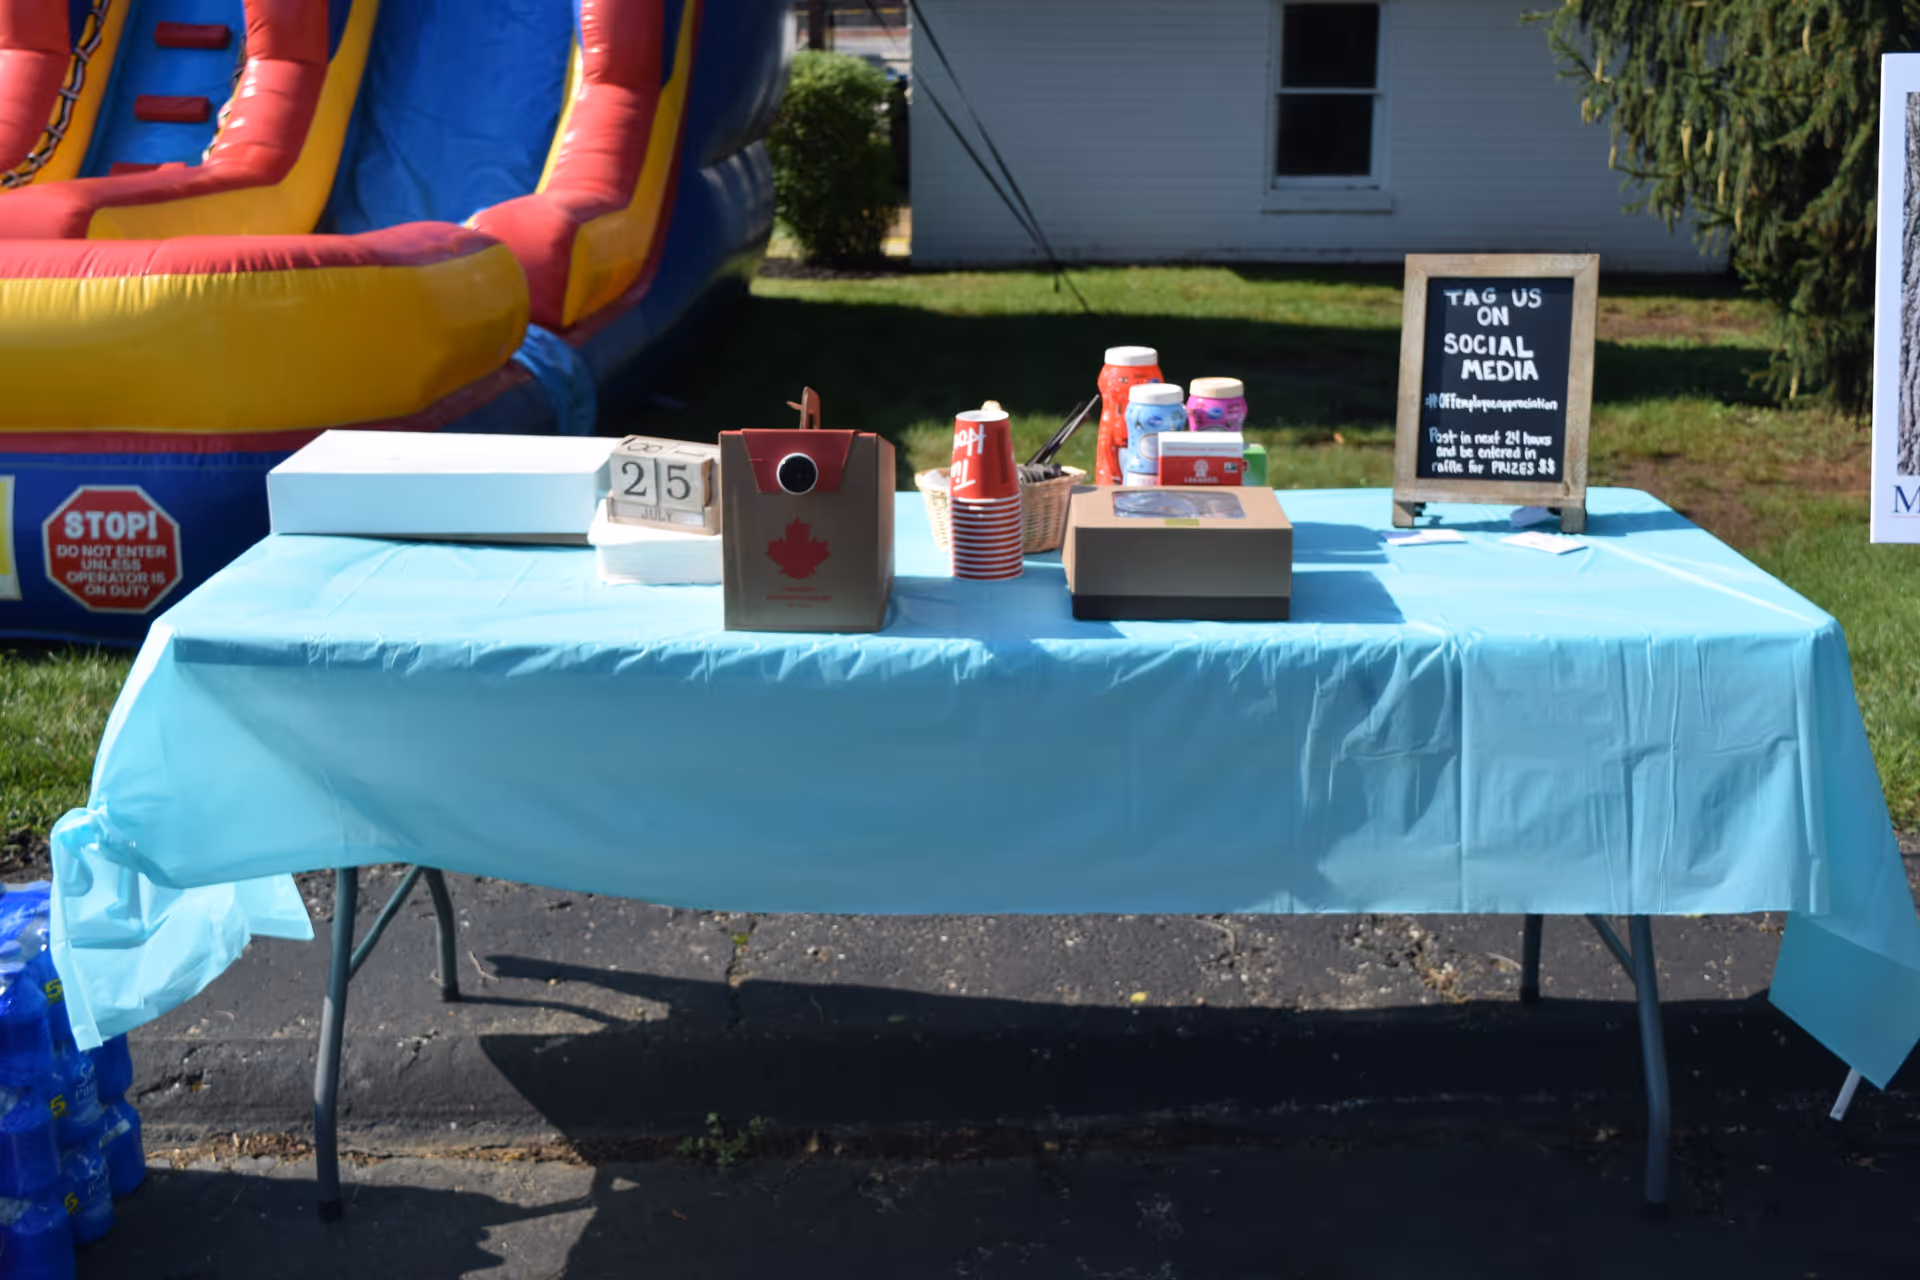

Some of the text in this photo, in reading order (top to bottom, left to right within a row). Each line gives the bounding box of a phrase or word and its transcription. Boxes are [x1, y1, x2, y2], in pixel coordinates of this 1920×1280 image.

[1443, 287, 1542, 309] TAG US
[1476, 306, 1510, 326] ON
[1443, 332, 1534, 359] SOCIAL
[1460, 359, 1539, 381] MEDIA
[1429, 427, 1552, 447] Post in next 24 hours
[1436, 445, 1537, 460] and be entered in
[1431, 459, 1464, 473] raffle
[1468, 459, 1485, 474] for
[1491, 461, 1535, 476] PRIZES
[641, 505, 674, 523] JULY
[64, 510, 158, 540] STOP!
[56, 545, 167, 558] DO NOT ENTER
[81, 558, 142, 571] UNLESS
[66, 571, 166, 585] OPERATOR IS
[85, 584, 150, 597] ON DUTY
